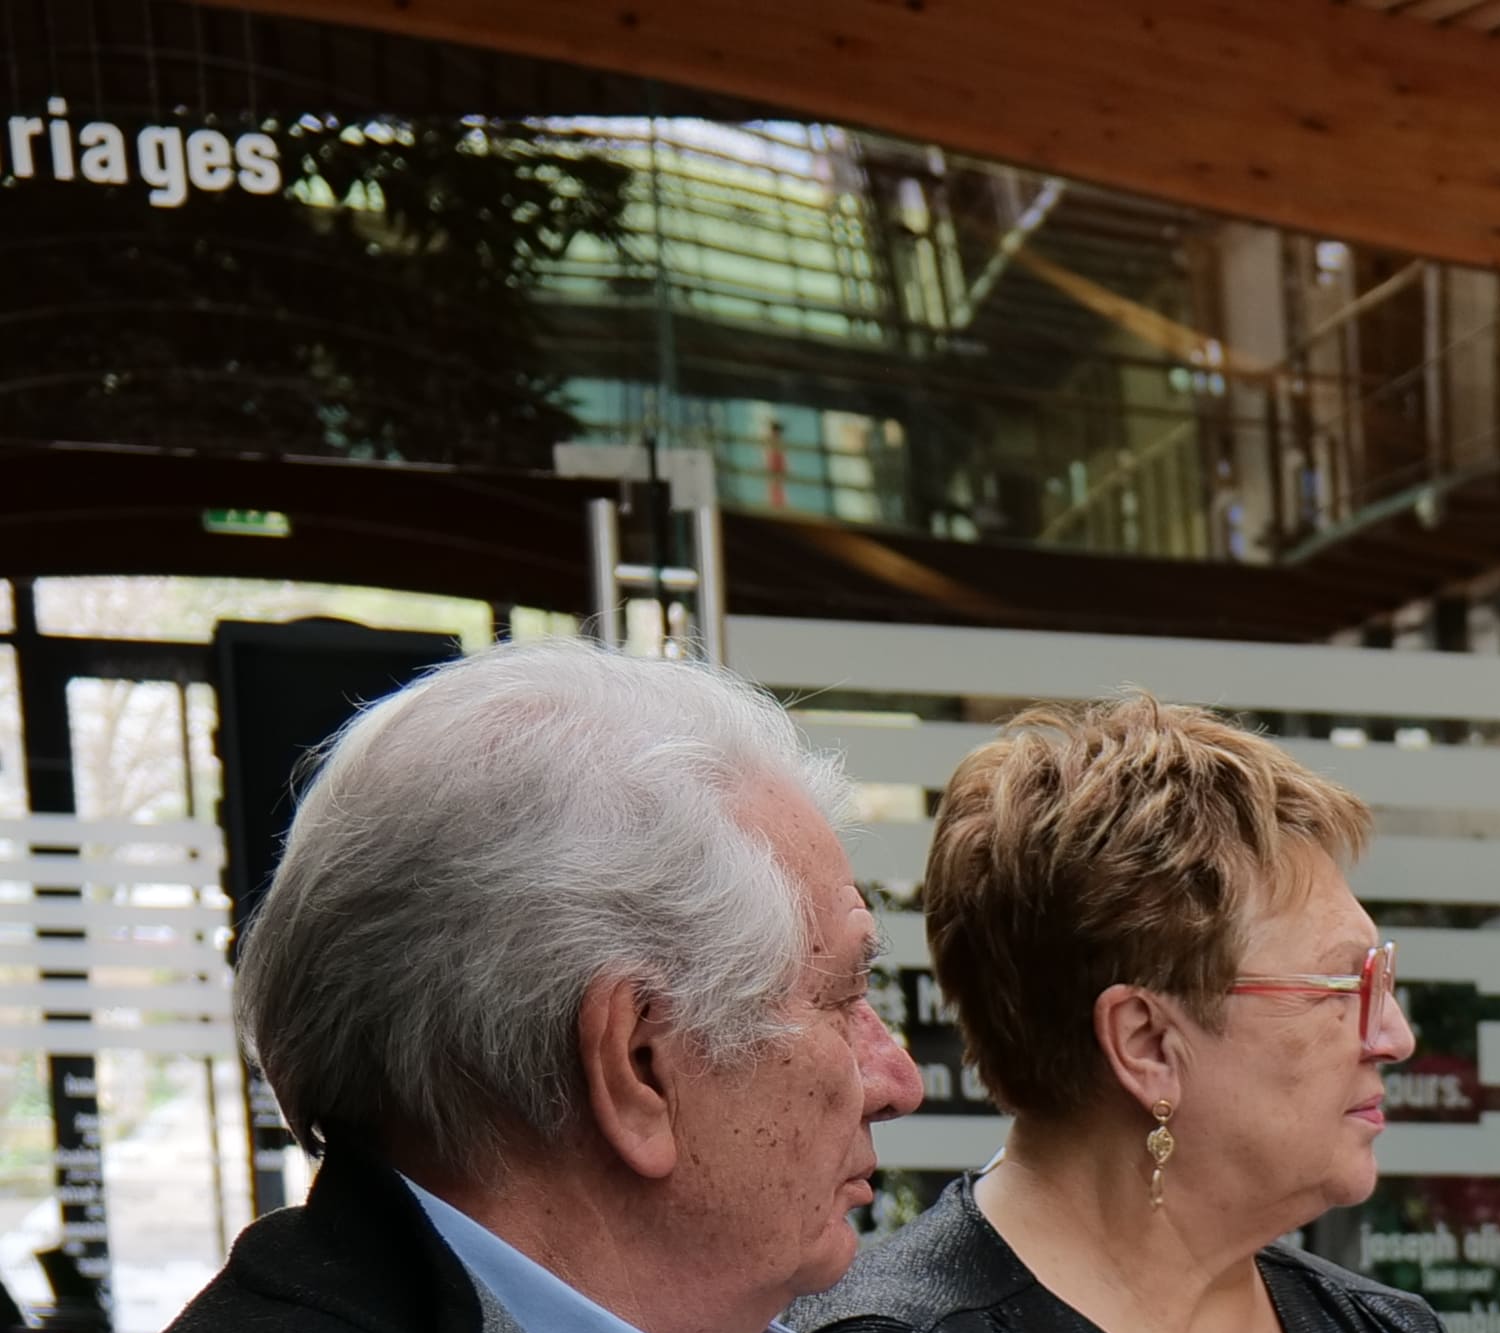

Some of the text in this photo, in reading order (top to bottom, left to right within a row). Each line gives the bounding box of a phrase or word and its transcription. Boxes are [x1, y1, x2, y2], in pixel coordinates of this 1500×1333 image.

[6, 96, 282, 208] riages
[1383, 1070, 1474, 1109] ours.
[1359, 1220, 1457, 1271] joseph
